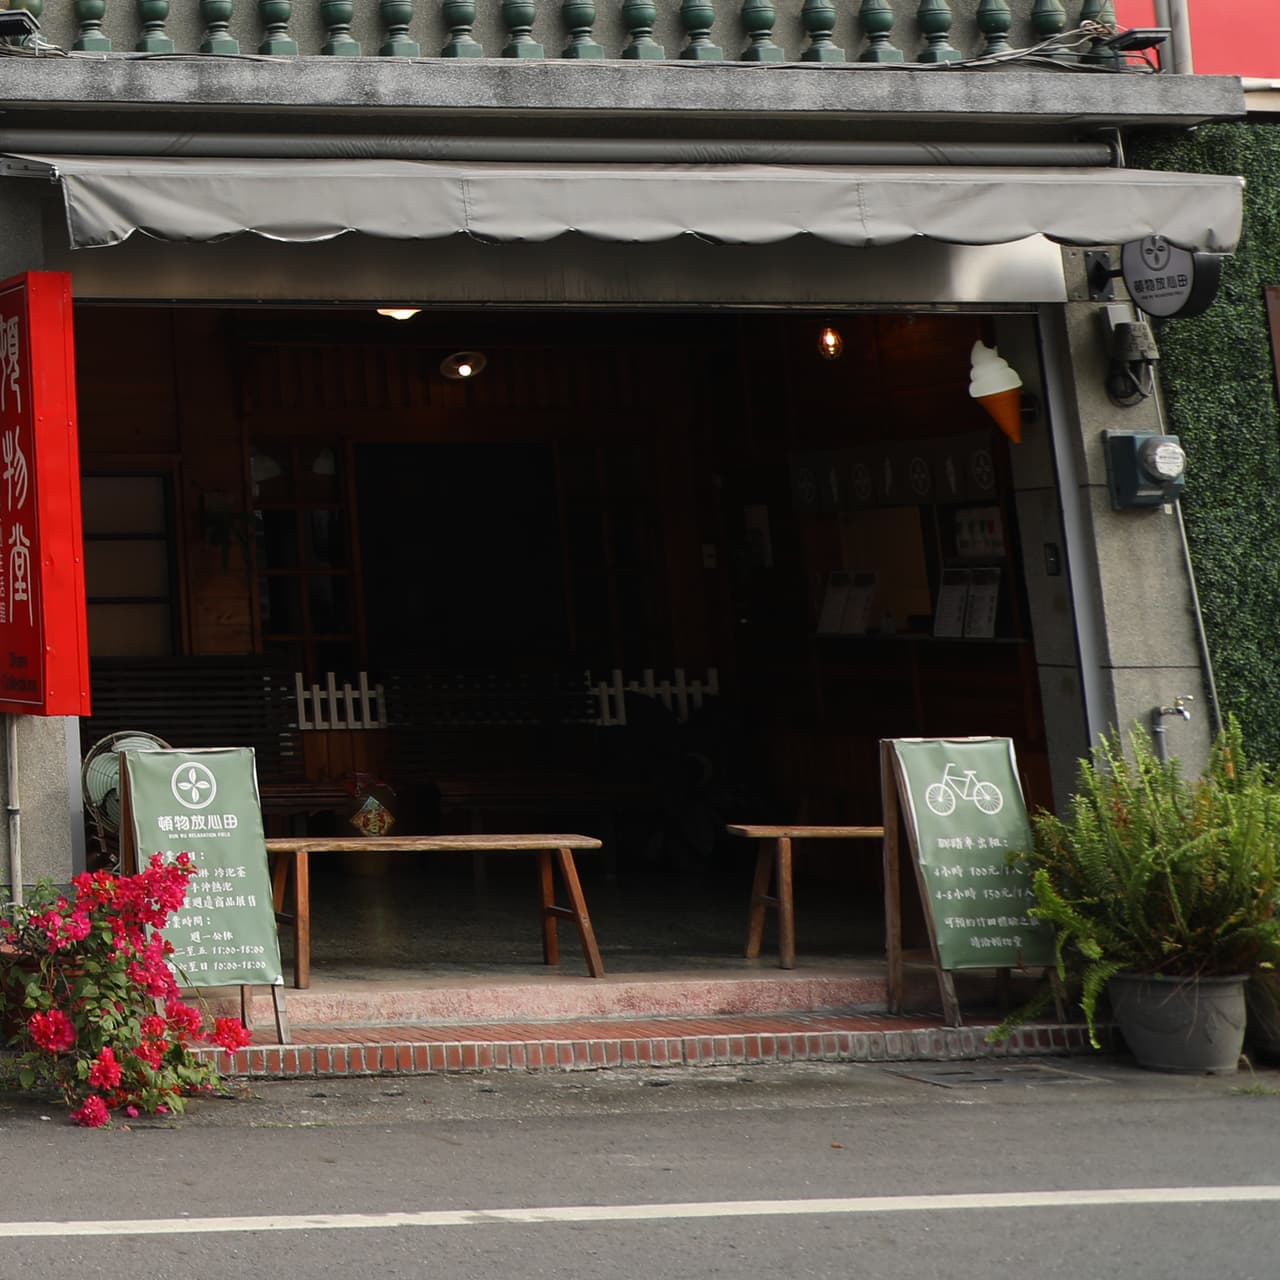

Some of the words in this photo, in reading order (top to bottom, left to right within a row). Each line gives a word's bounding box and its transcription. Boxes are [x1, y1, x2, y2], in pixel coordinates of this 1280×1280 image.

[157, 814, 238, 831] 頓物放心田
